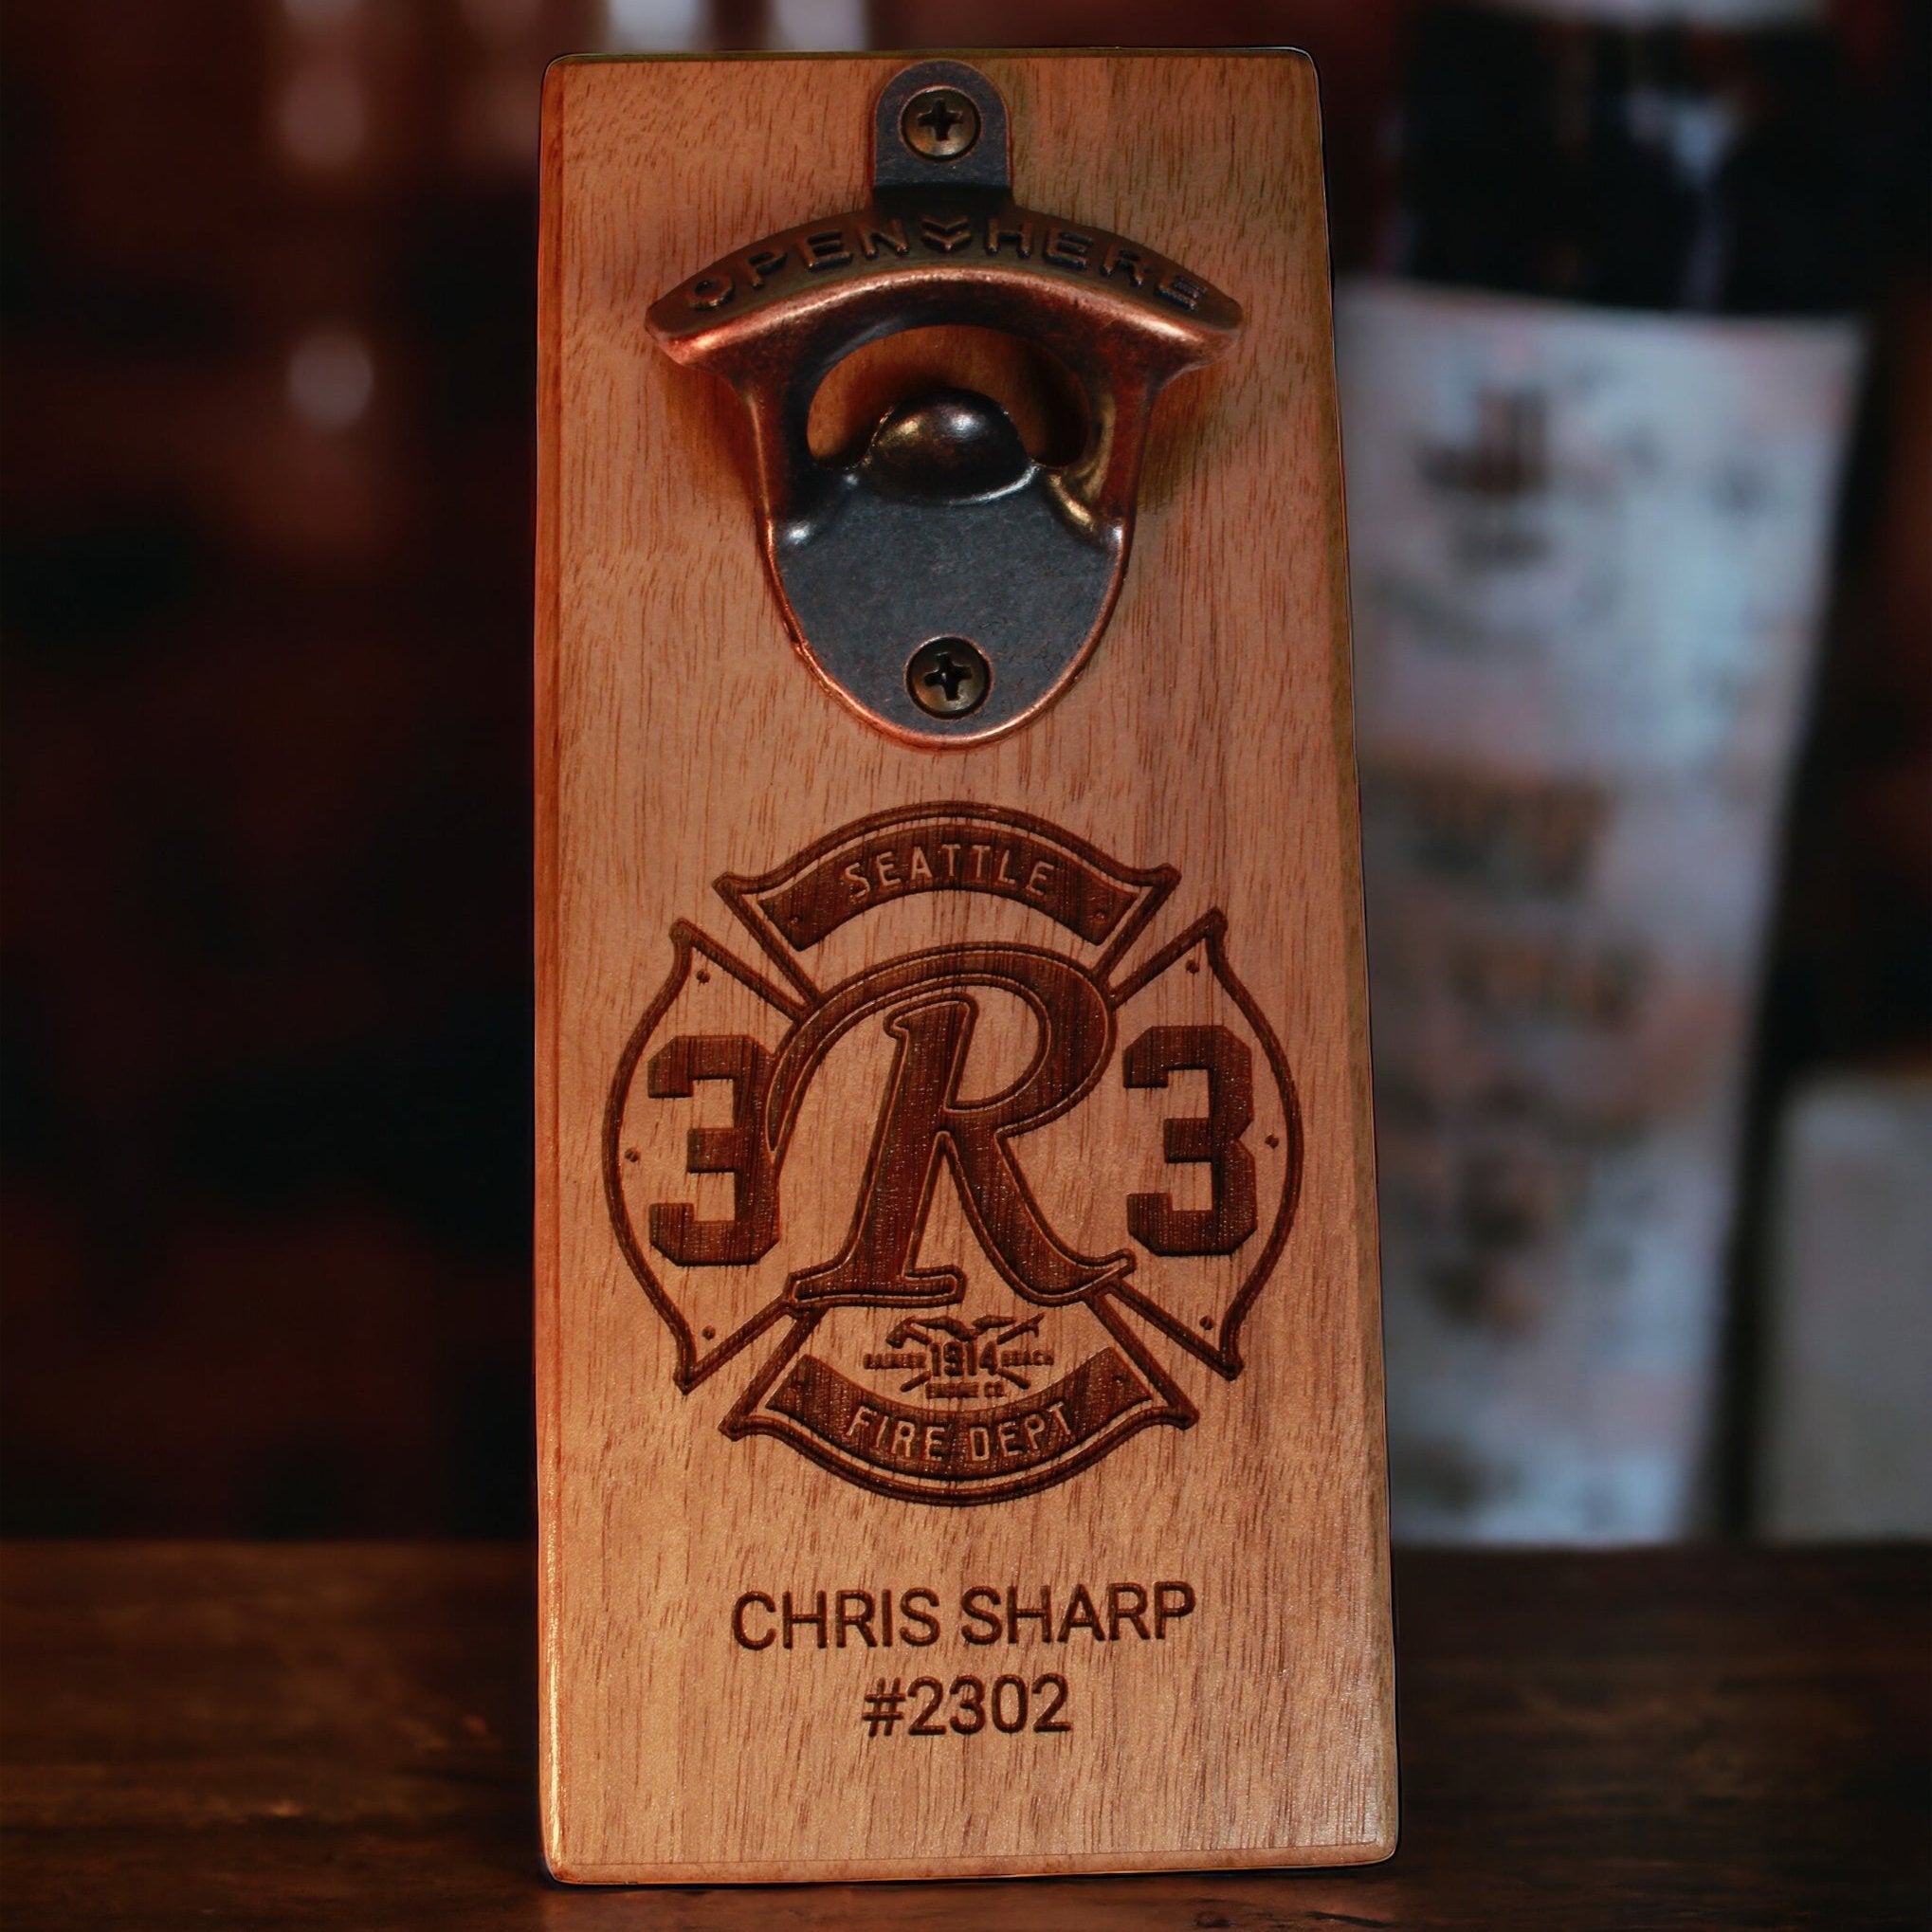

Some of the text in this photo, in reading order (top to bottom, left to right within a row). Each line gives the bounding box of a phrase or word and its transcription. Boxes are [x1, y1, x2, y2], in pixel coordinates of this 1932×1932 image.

[689, 218, 1209, 311] OPEN HERE
[842, 843, 1054, 899] SEATTLE
[764, 942, 1135, 1307] R
[1122, 1025, 1259, 1256] 3
[931, 1340, 998, 1377] 1914
[846, 1400, 1071, 1462] FIRE DEPT
[731, 1581, 1197, 1650] CHRIS SHARP
[862, 1672, 1072, 1738] #2302
